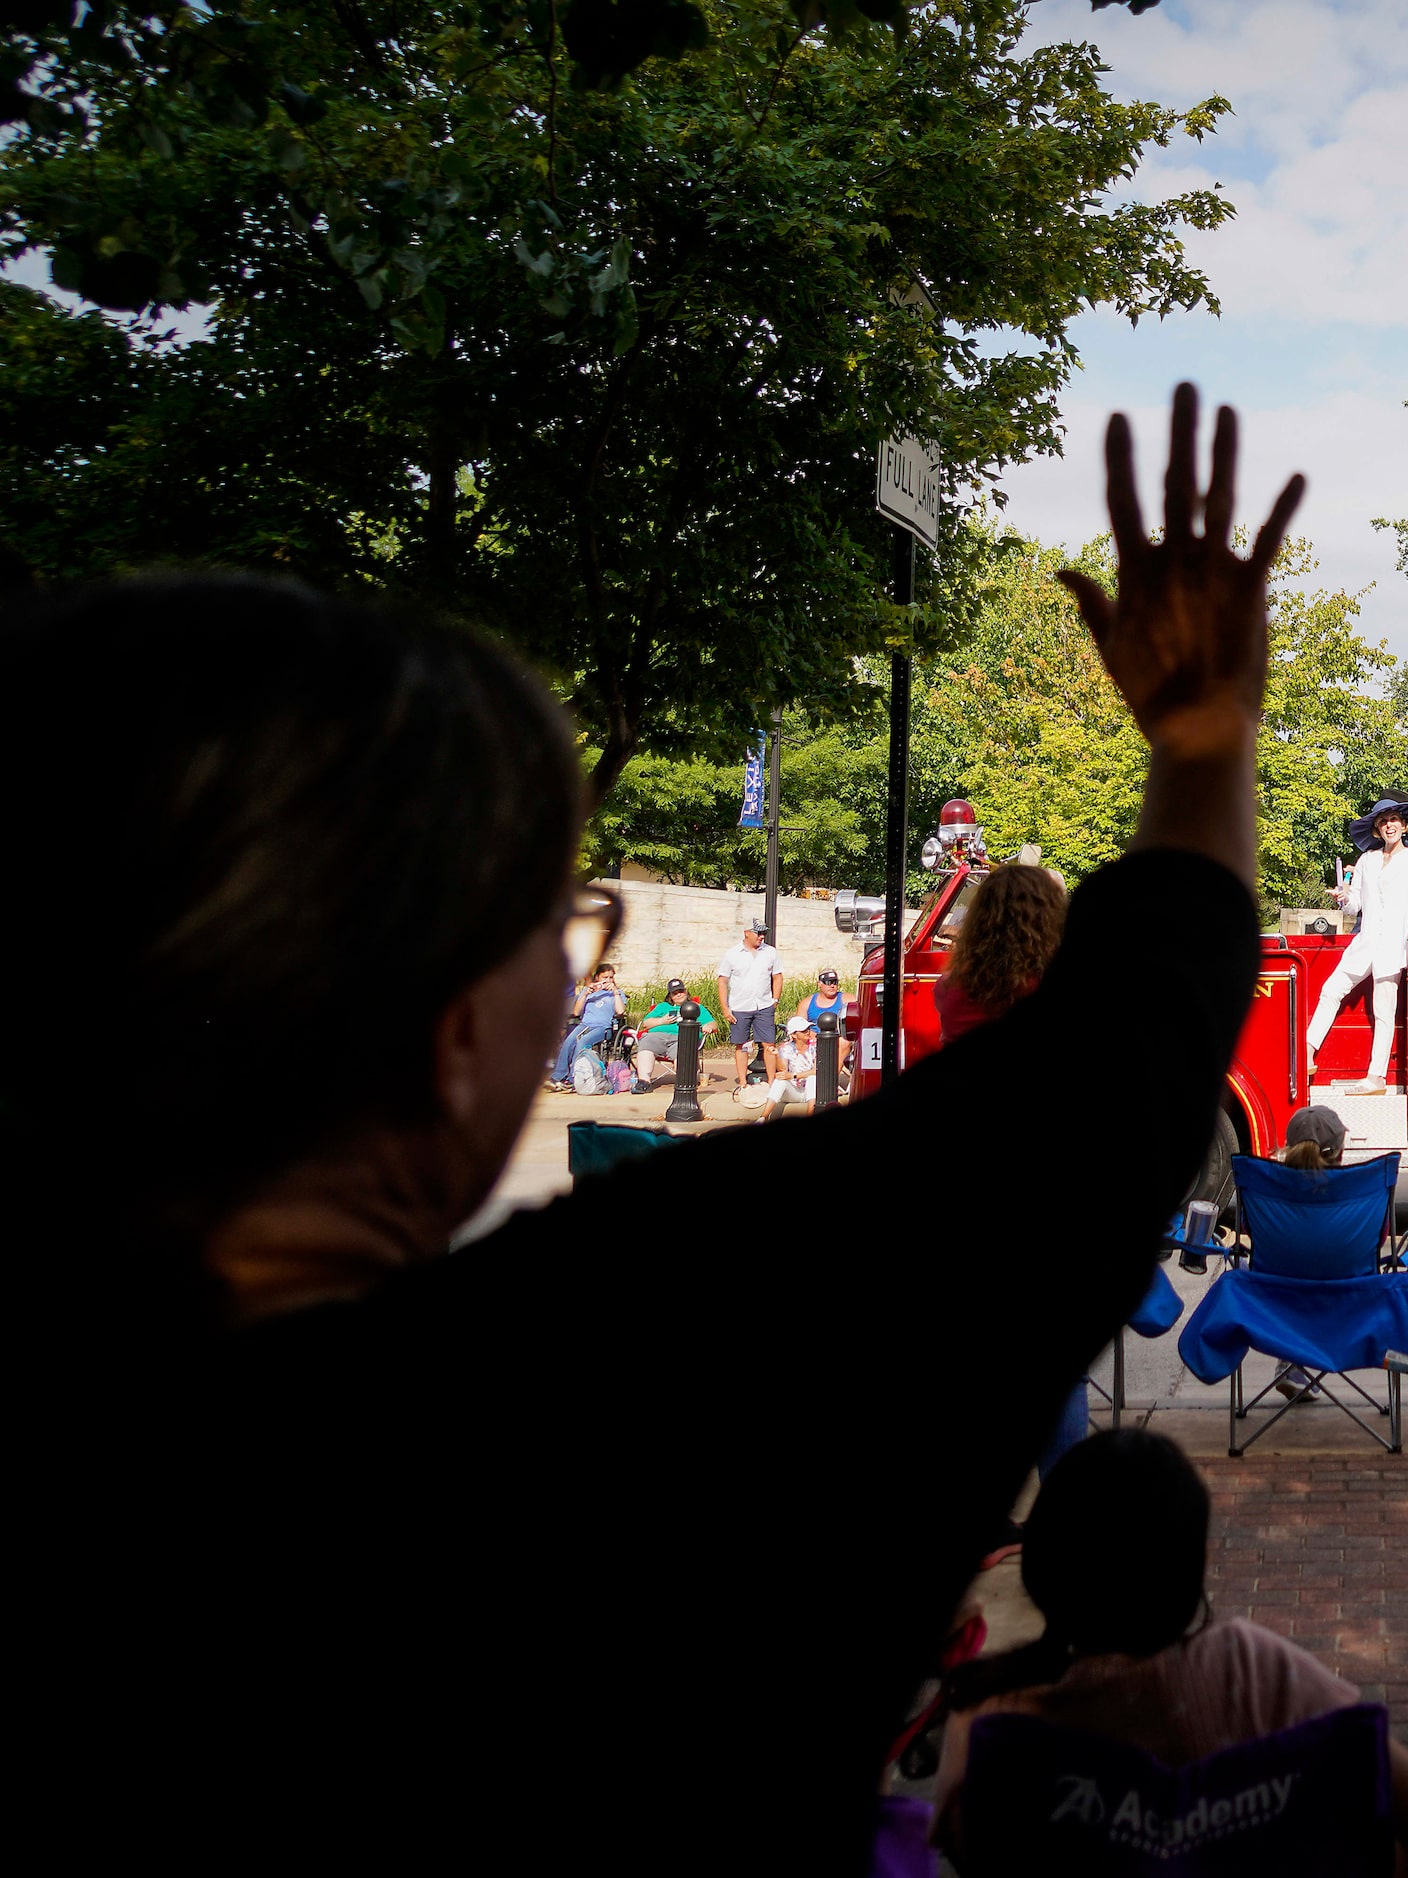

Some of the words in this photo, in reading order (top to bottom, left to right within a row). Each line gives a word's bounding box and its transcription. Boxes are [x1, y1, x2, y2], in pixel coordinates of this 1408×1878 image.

[886, 446, 914, 499] FULL
[918, 469, 935, 518] LANE
[1111, 1772, 1293, 1848] Academy
